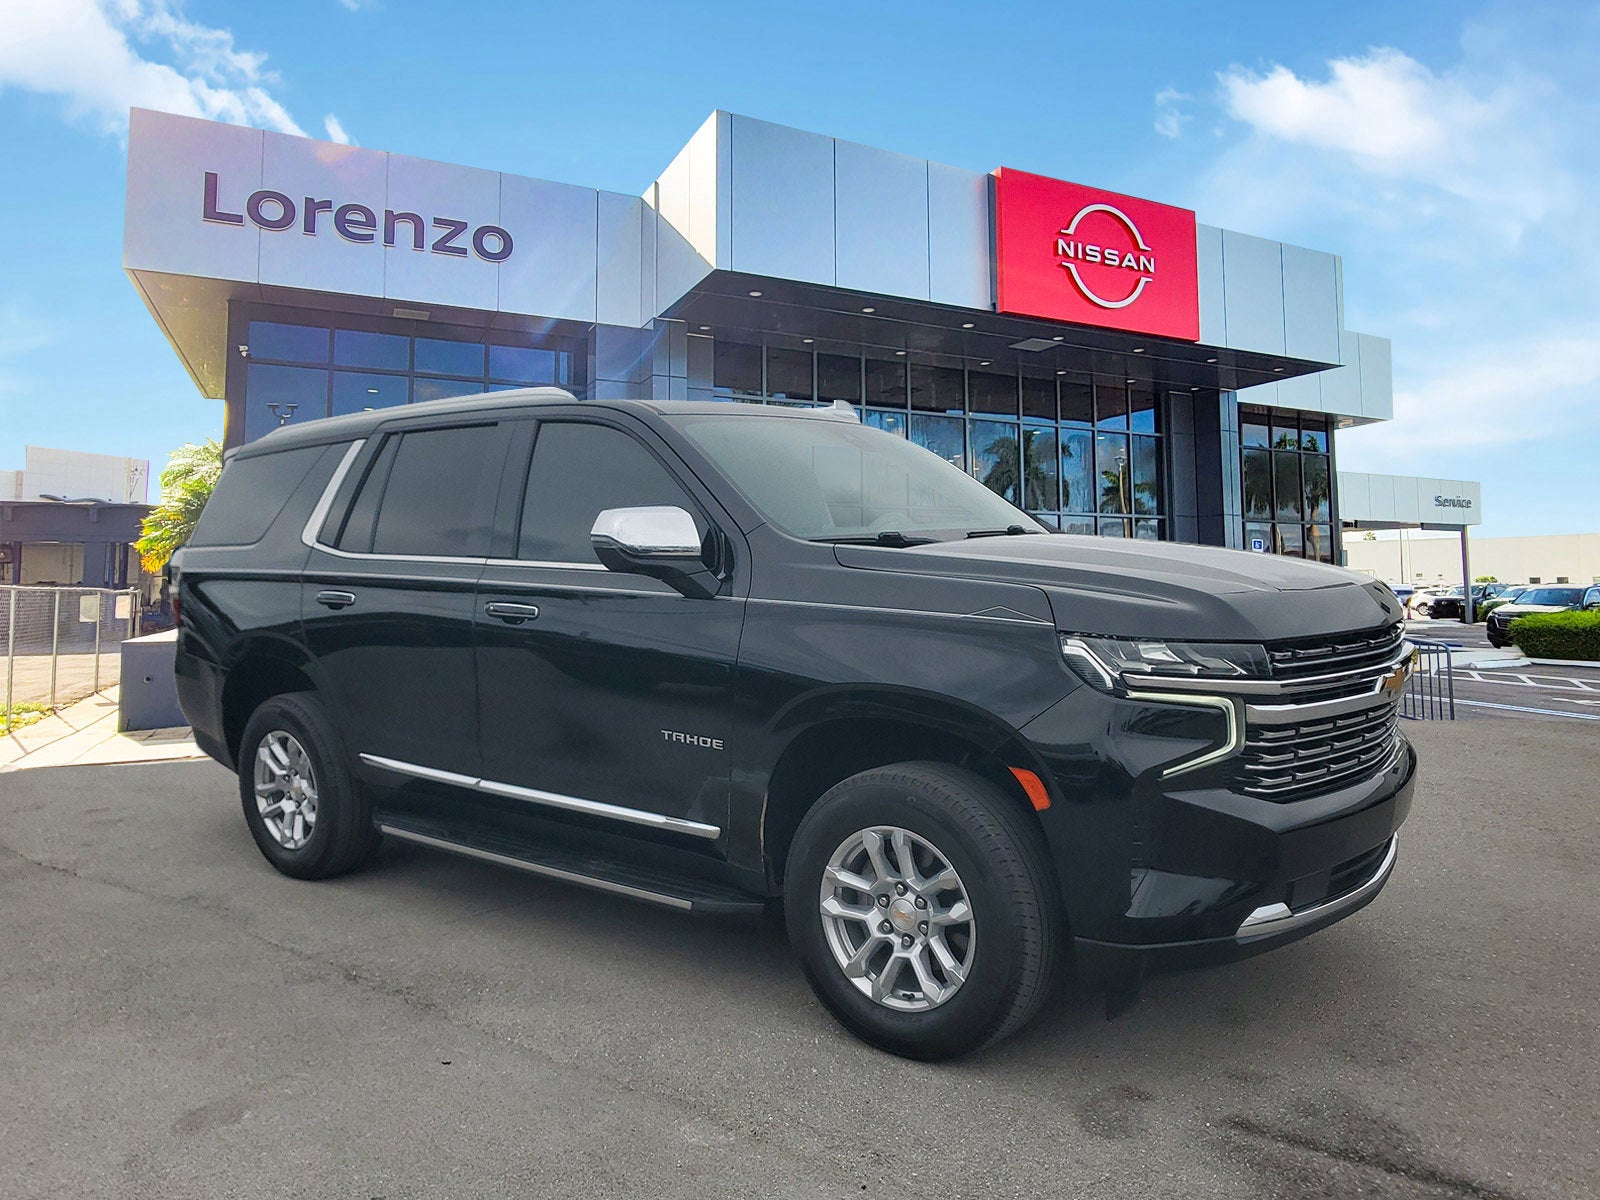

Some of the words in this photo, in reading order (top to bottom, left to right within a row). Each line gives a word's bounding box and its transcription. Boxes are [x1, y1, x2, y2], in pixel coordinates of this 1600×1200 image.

[202, 171, 514, 262] Lorenzo
[1057, 238, 1155, 273] NISSAN
[1434, 495, 1472, 509] Service
[661, 729, 723, 750] TAHOE
